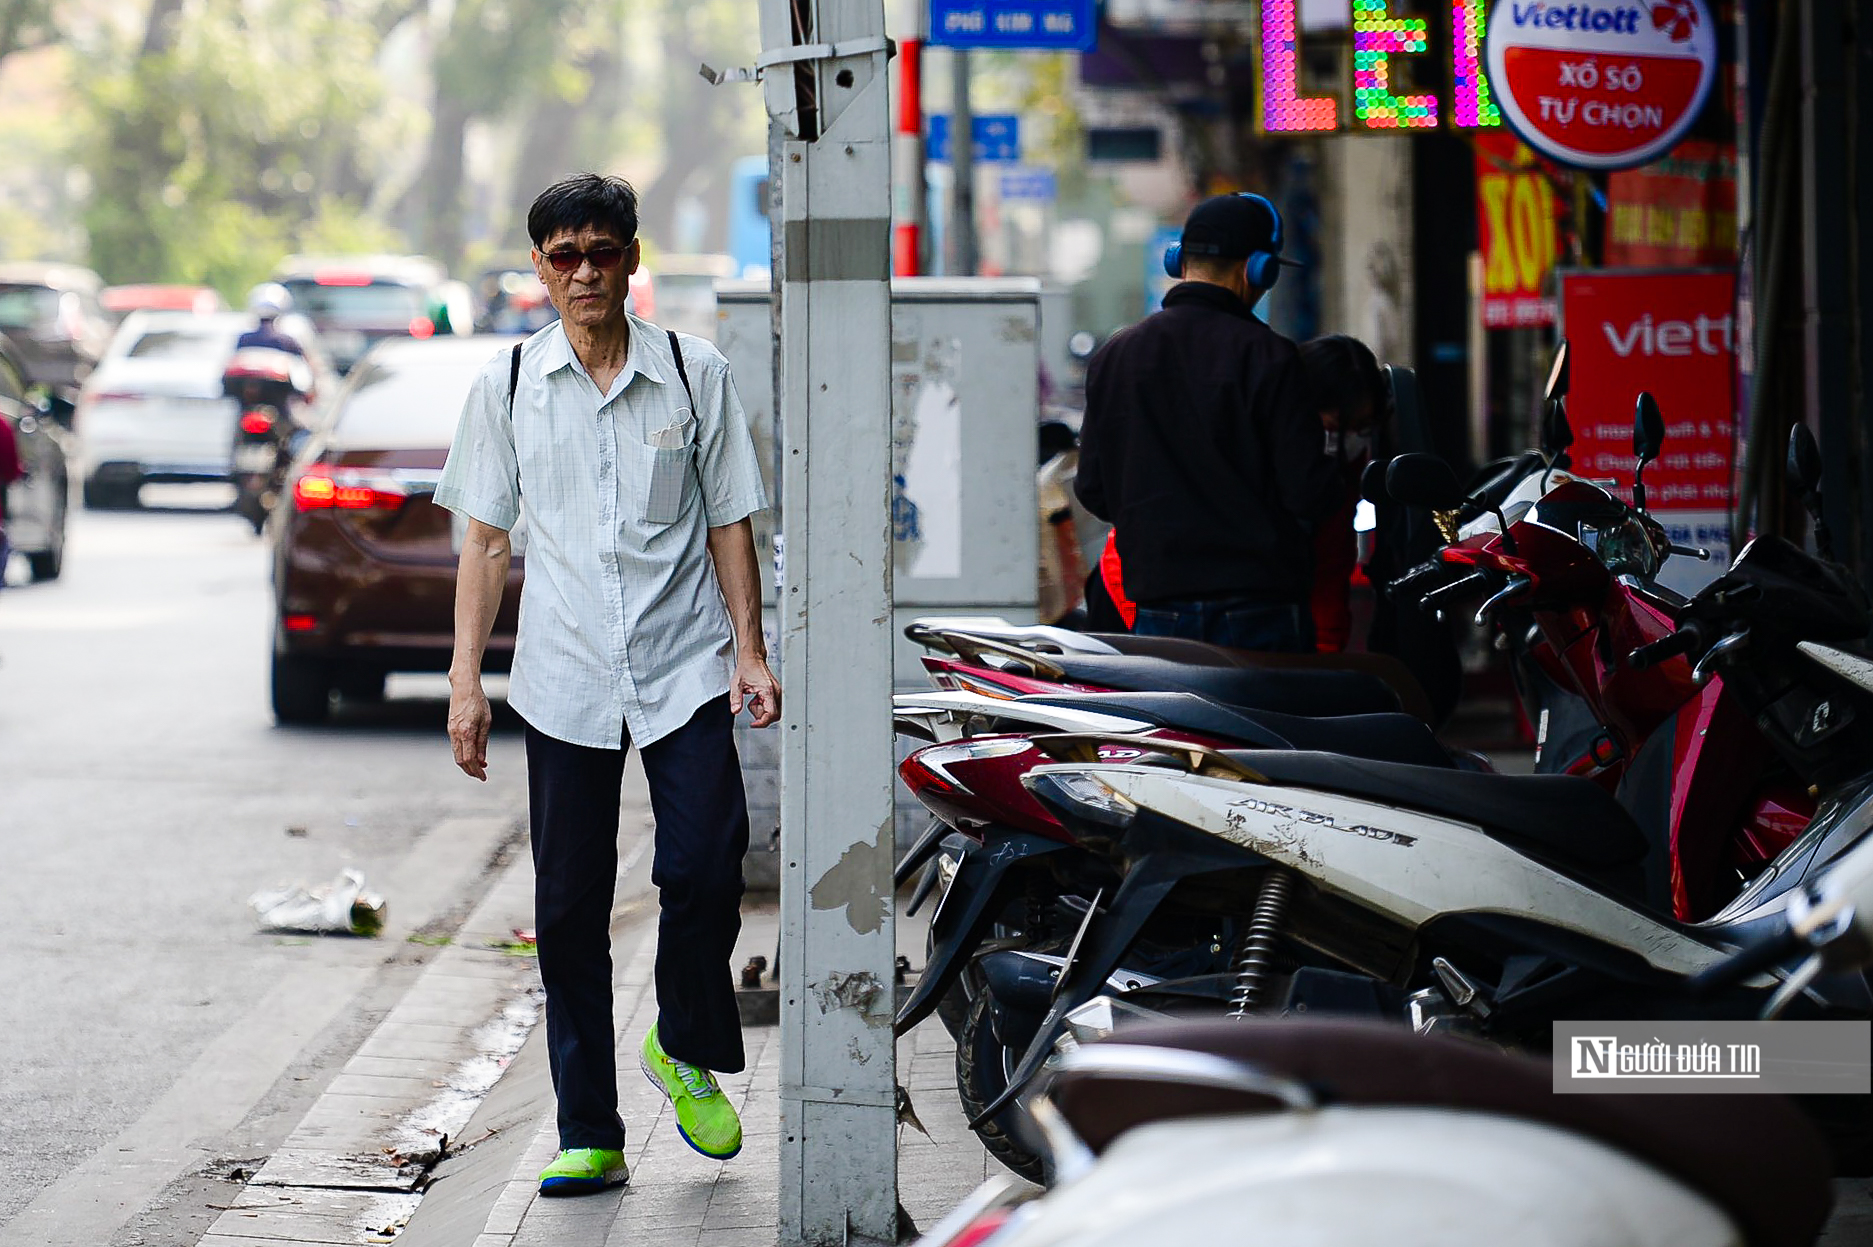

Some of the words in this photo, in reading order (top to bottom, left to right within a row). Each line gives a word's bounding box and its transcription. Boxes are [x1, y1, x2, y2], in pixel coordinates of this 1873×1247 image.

[1511, 1, 1643, 34] Vietlott
[1558, 54, 1599, 89] XỔ
[1604, 58, 1643, 93] SỐ
[1538, 96, 1579, 129] TỰ
[1582, 101, 1664, 135] CHỌN
[1226, 797, 1294, 819] AIR
[1296, 809, 1419, 848] BLADE
